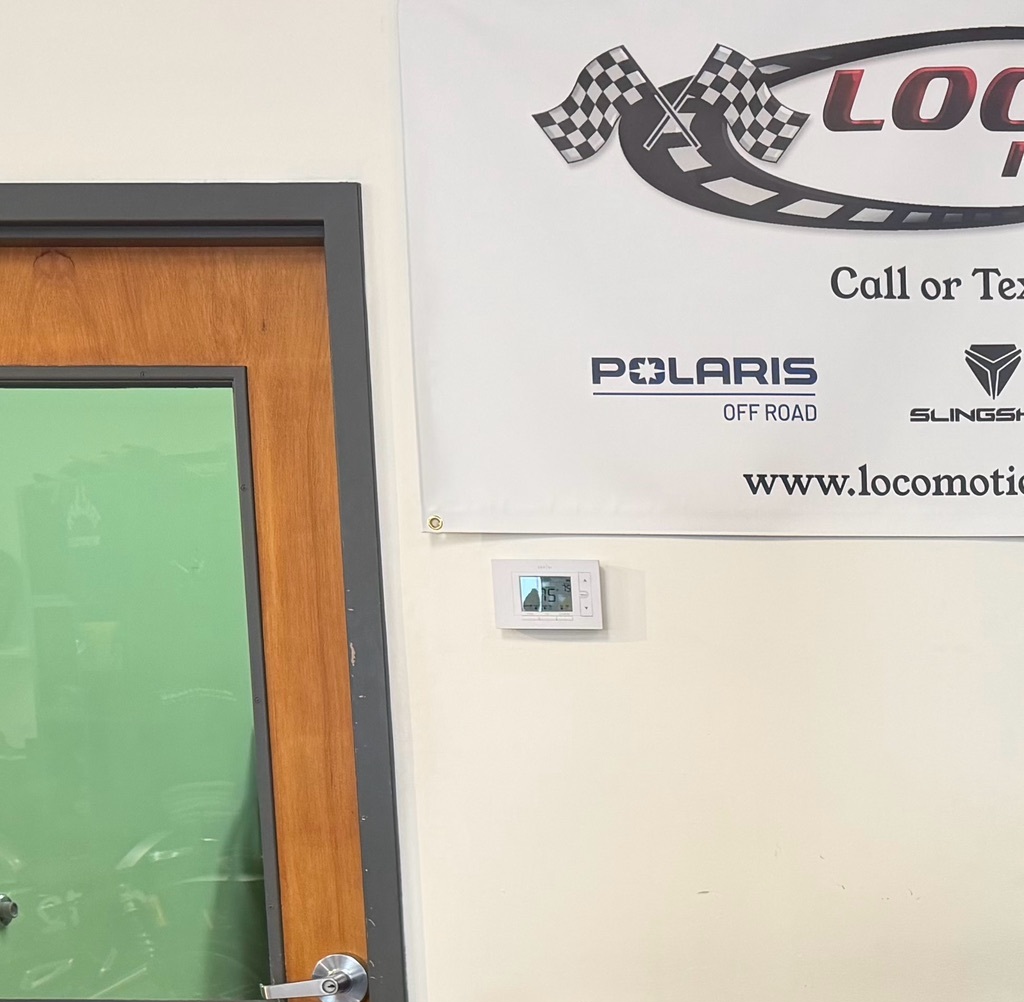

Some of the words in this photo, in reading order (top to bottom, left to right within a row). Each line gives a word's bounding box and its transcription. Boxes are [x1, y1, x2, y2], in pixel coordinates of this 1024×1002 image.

[831, 266, 910, 299] Call
[921, 277, 962, 300] or
[591, 357, 818, 385] POLARIS
[723, 403, 760, 421] OFF
[765, 403, 817, 421] ROAD
